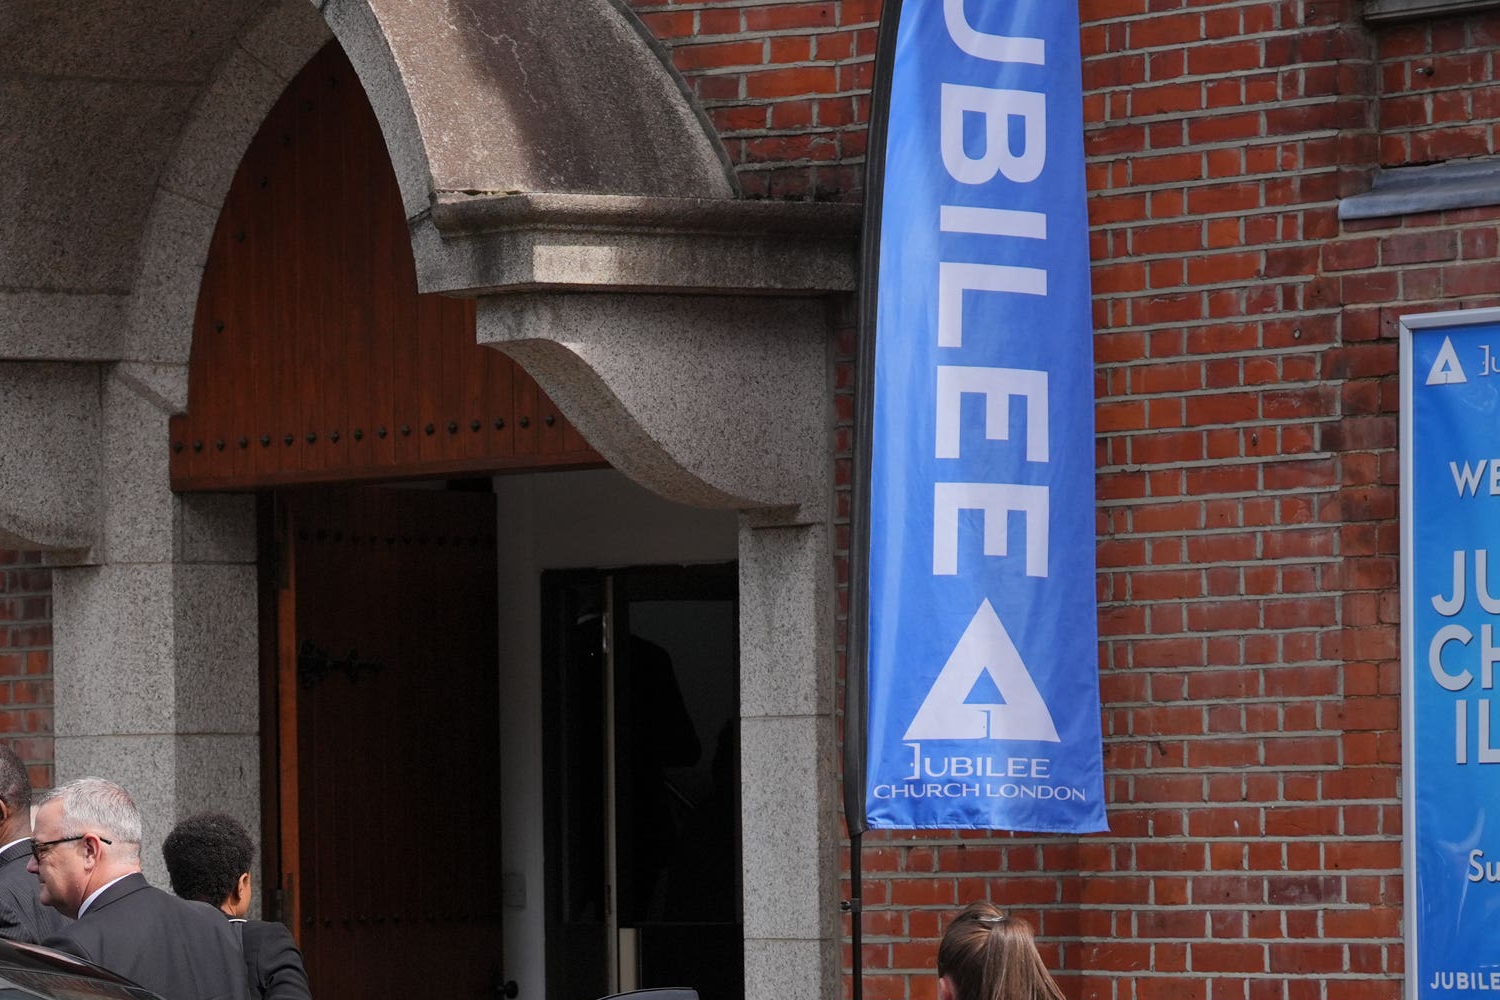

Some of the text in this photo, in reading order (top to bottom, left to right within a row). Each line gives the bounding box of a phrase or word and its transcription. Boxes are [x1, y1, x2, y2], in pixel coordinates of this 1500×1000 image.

[1450, 459, 1500, 499] WE
[1456, 699, 1500, 764] IL
[902, 742, 1051, 780] JUBILEE
[873, 783, 1087, 802] CHURCH LONDON
[1430, 972, 1500, 990] JUBILE
